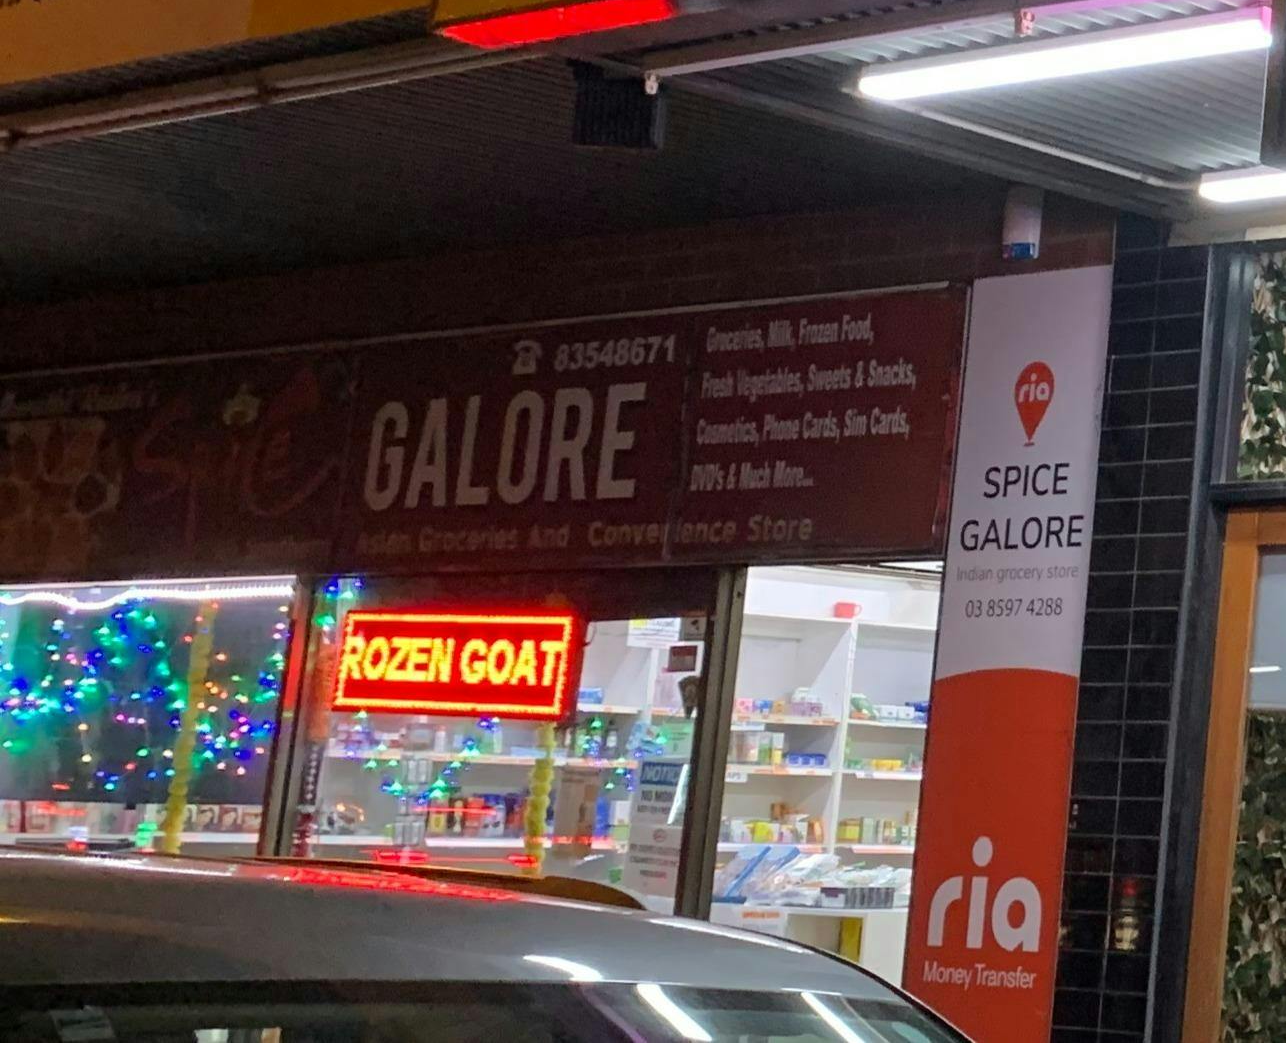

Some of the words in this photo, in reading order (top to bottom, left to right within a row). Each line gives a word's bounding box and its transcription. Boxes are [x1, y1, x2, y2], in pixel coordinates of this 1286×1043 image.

[799, 318, 838, 345] Frozen
[841, 312, 874, 345] Food,
[554, 336, 677, 372] 83548671
[700, 371, 733, 398] Fresh
[807, 363, 850, 391] Sweets
[855, 360, 864, 388] &
[867, 358, 917, 389] Snacks,
[1018, 373, 1050, 403] ria
[763, 414, 799, 441] Phone
[802, 410, 840, 443] Cards,
[843, 408, 867, 437] Sim
[870, 405, 910, 439] Cards,
[363, 382, 647, 512] GALORE
[739, 461, 771, 490] Much
[983, 463, 1070, 499] SPICE
[418, 526, 518, 551] Groceries
[529, 522, 570, 548] And
[588, 519, 737, 546] Conveience
[747, 514, 813, 542] Store
[960, 514, 1084, 552] GALORE
[956, 565, 993, 582] Indian
[997, 566, 1042, 584] grocery
[1047, 563, 1079, 579] store
[965, 600, 983, 618] 03
[986, 598, 1022, 618] 8597
[1026, 596, 1063, 617] 4288
[342, 634, 454, 683] ROZEN
[459, 638, 567, 687] GOAT
[927, 835, 1042, 953] ria
[923, 961, 972, 990] Money
[975, 963, 1037, 989] Transfer
